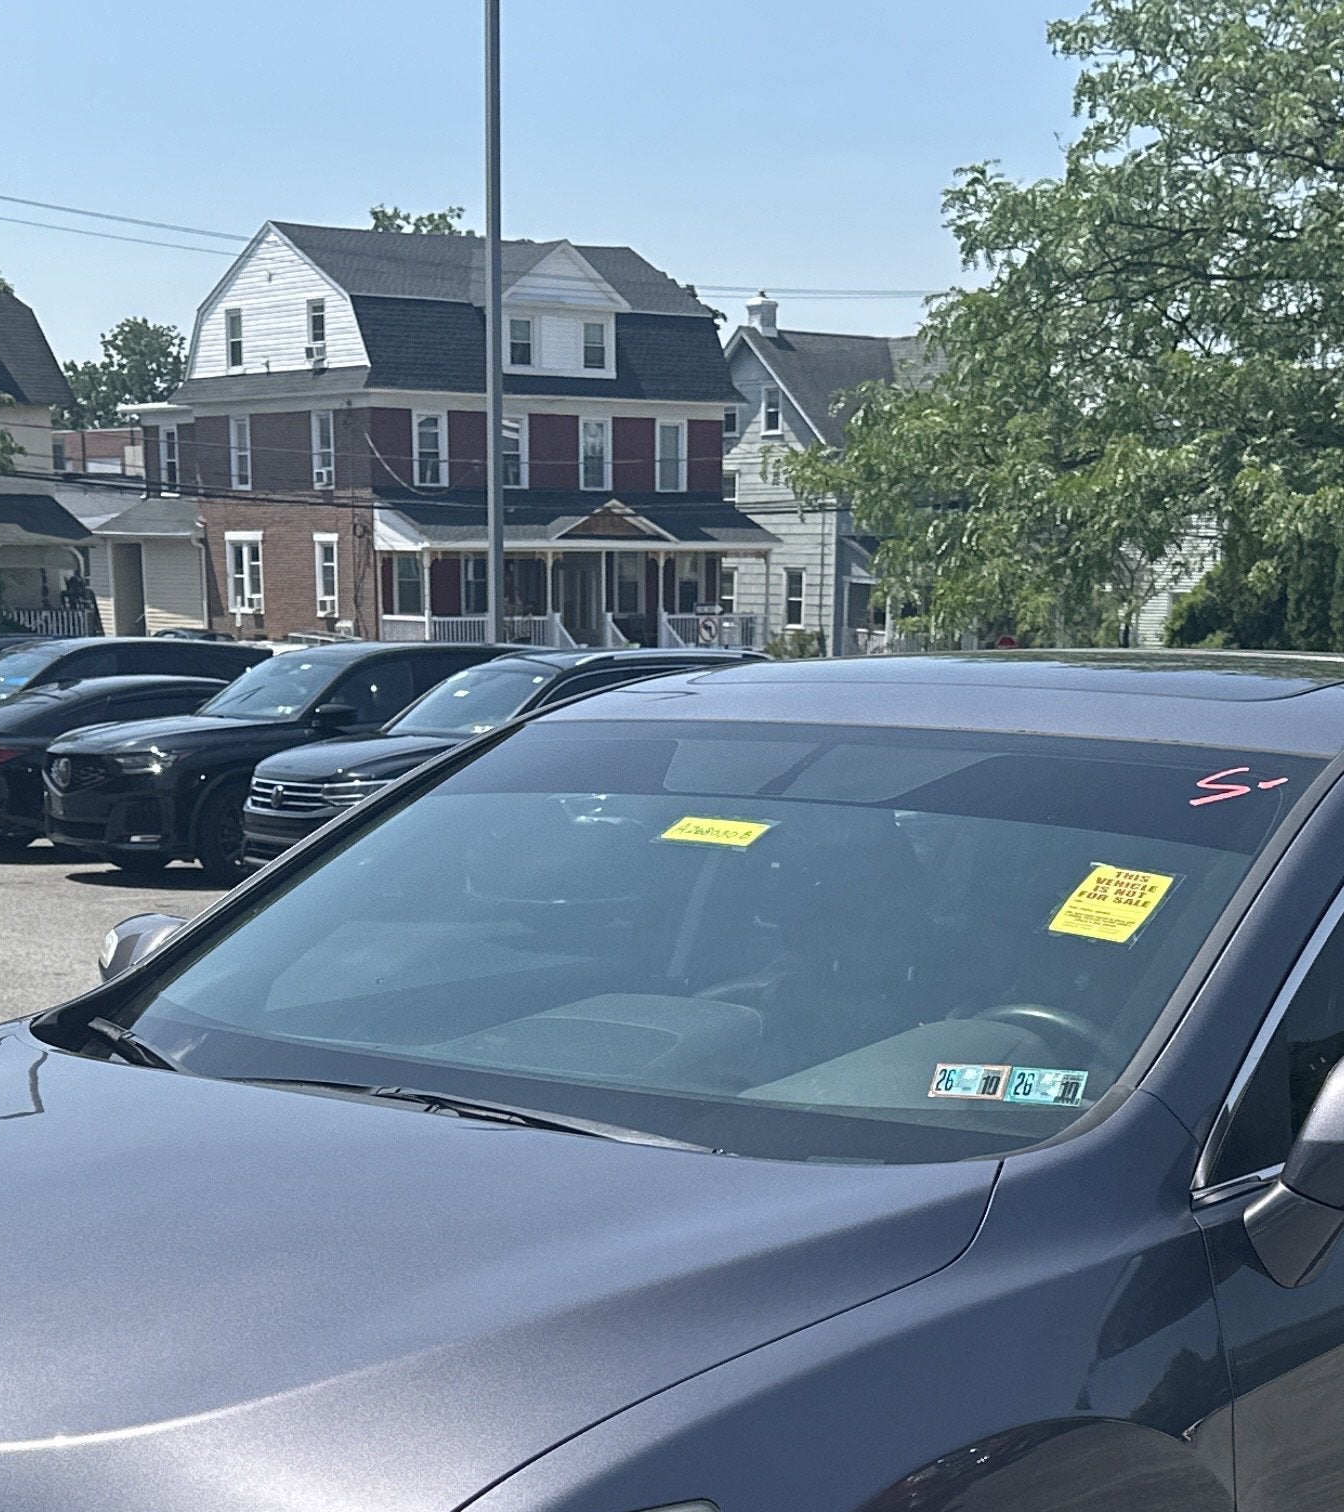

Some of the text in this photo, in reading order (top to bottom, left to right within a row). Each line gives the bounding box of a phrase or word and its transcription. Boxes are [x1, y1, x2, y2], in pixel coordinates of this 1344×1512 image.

[1096, 877, 1158, 892] VEHICLE
[1114, 871, 1151, 883] THIS
[1077, 890, 1151, 908] FOR SALE
[1092, 885, 1148, 899] IS NOT
[935, 1068, 957, 1092] 26
[981, 1075, 1001, 1096] 10
[1013, 1072, 1035, 1096] 26
